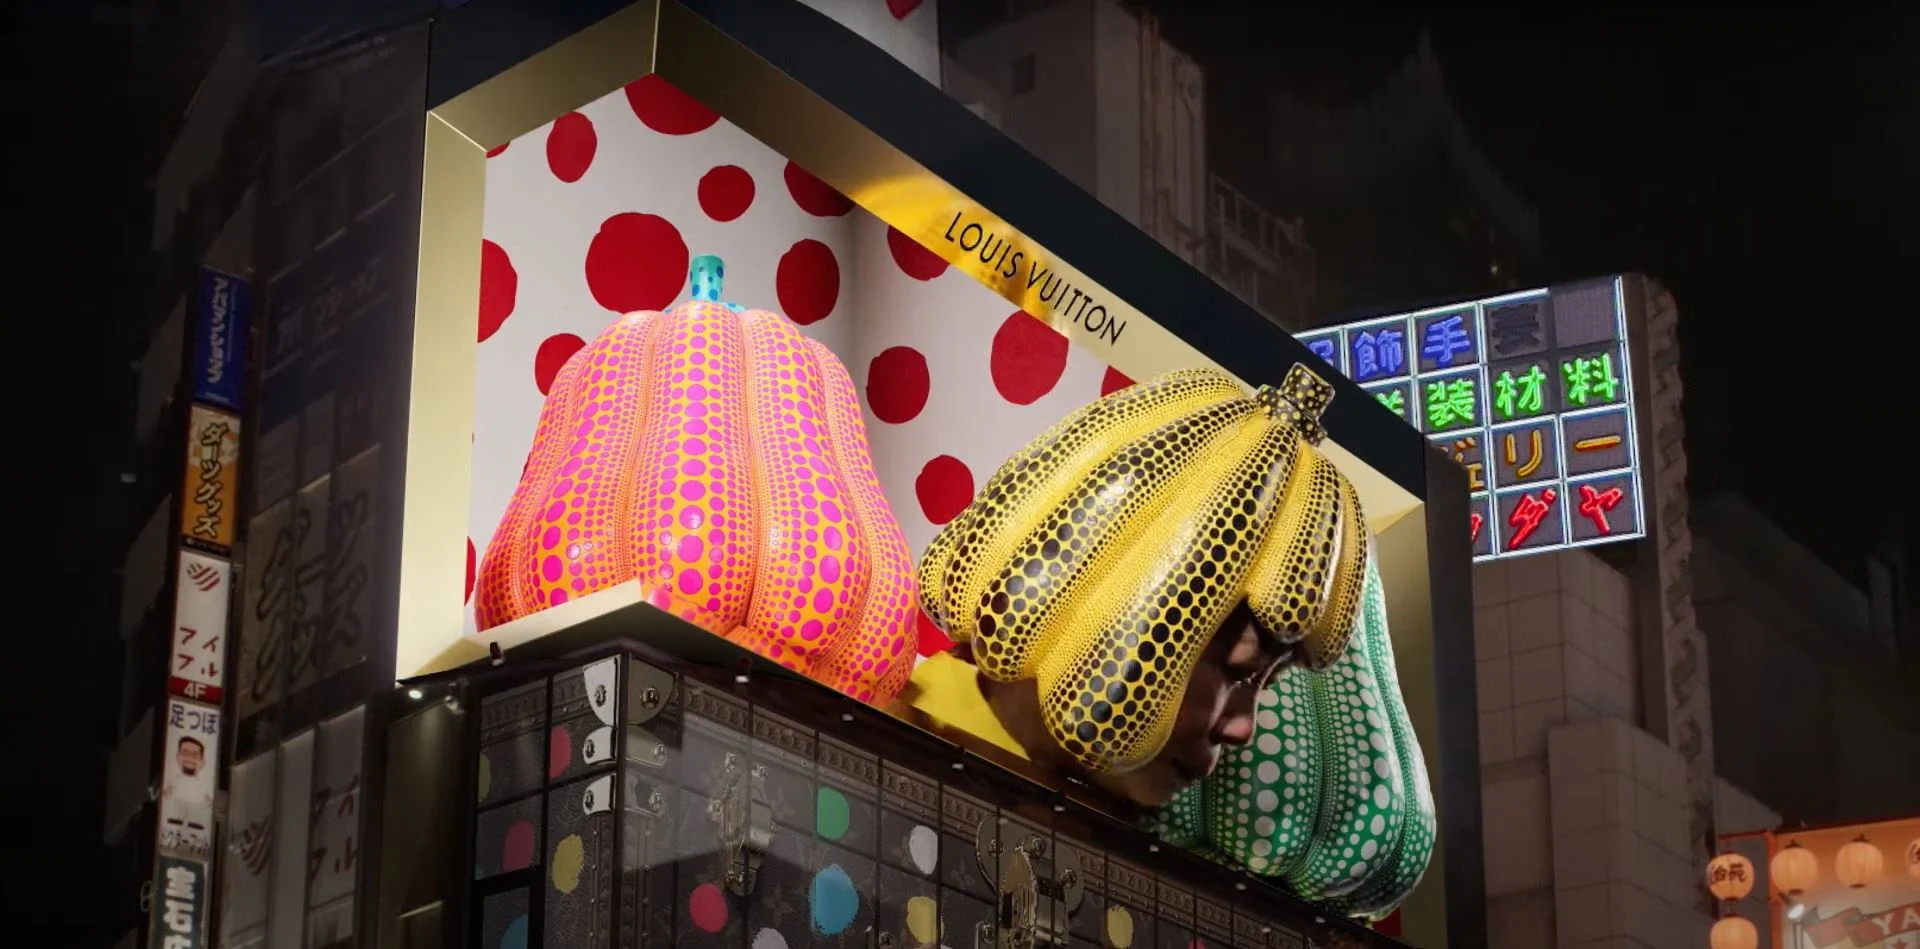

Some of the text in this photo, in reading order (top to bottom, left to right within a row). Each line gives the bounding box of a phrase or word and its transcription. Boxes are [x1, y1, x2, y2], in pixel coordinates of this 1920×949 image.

[944, 211, 1127, 345] LOUIS VUITTON
[193, 422, 229, 539] ダーツグッズ
[1470, 483, 1624, 551] ダヤ
[182, 681, 207, 699] 4F
